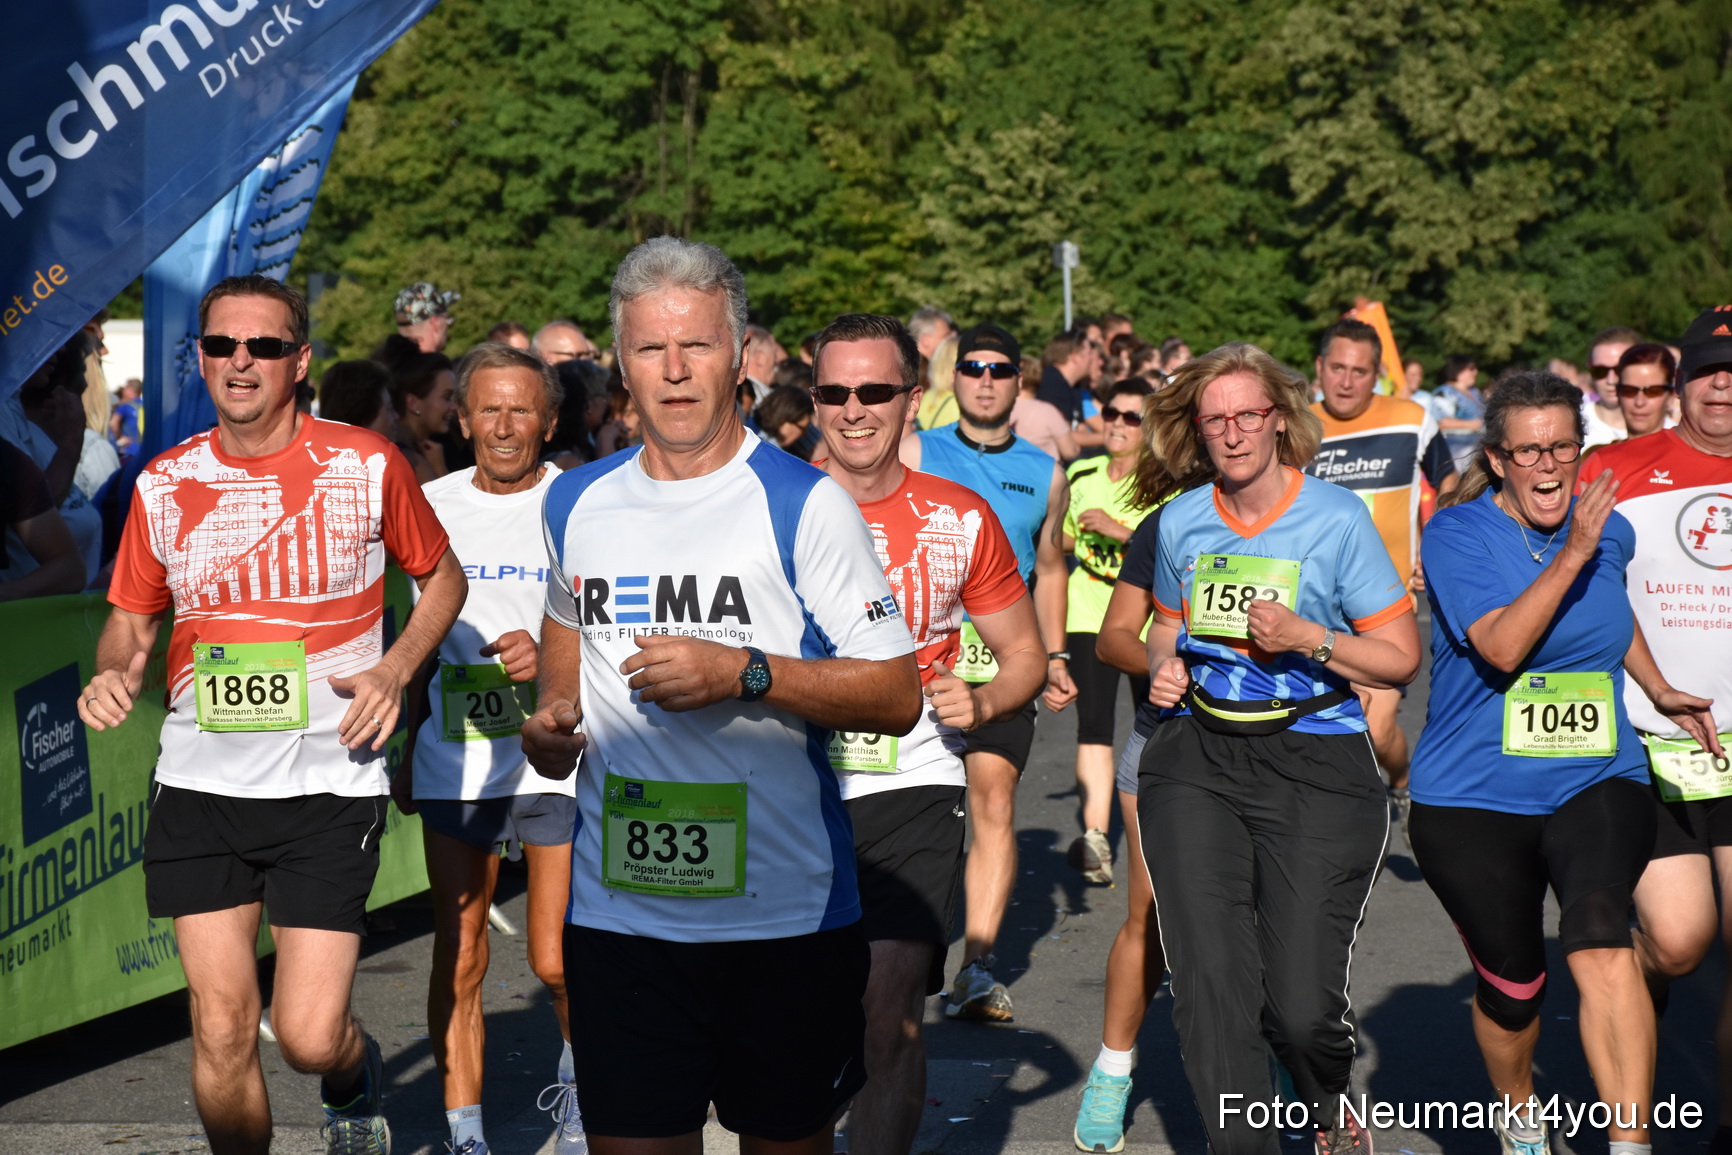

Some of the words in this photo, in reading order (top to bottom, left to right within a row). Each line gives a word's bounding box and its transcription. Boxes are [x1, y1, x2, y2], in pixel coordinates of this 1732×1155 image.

[198, 4, 303, 98] Druck
[1315, 457, 1392, 477] Fischer
[1001, 481, 1035, 496] THULE
[210, 537, 247, 549] 26.22
[461, 565, 551, 582] ELPHI
[1711, 585, 1732, 597] MI
[1660, 602, 1677, 612] Dr.
[1679, 602, 1708, 613] Heck
[1710, 603, 1716, 614] /
[1661, 618, 1732, 631] Leistungsdia
[618, 627, 669, 639] FILTER
[675, 627, 754, 642] Technology
[204, 657, 239, 665] firmenlauf
[206, 674, 290, 706] 1868
[1521, 686, 1558, 695] firmenlauf
[212, 707, 252, 716] Wittmann
[254, 707, 284, 715] Stefan
[466, 691, 503, 719] 20
[234, 715, 293, 723] Neumarkt-Parsberg
[466, 720, 487, 728] Meier
[488, 716, 511, 726] Josef
[1520, 703, 1599, 734] 1049
[32, 719, 76, 760] Fischer
[1533, 735, 1557, 743] Gradl
[1558, 735, 1588, 744] Brigitte
[840, 746, 879, 755] Matthias
[38, 746, 75, 774] AUTOMOBILE
[829, 756, 882, 764] eumarkt-Parsberg
[618, 794, 663, 809] firmenlauf
[667, 809, 696, 818] 2018
[626, 820, 709, 865] 833
[0, 775, 153, 932] irmenlau
[623, 861, 669, 877] Pröpster
[671, 866, 715, 879] Ludwig
[631, 874, 677, 886] IREMA-Filter
[678, 879, 704, 887] GmbH
